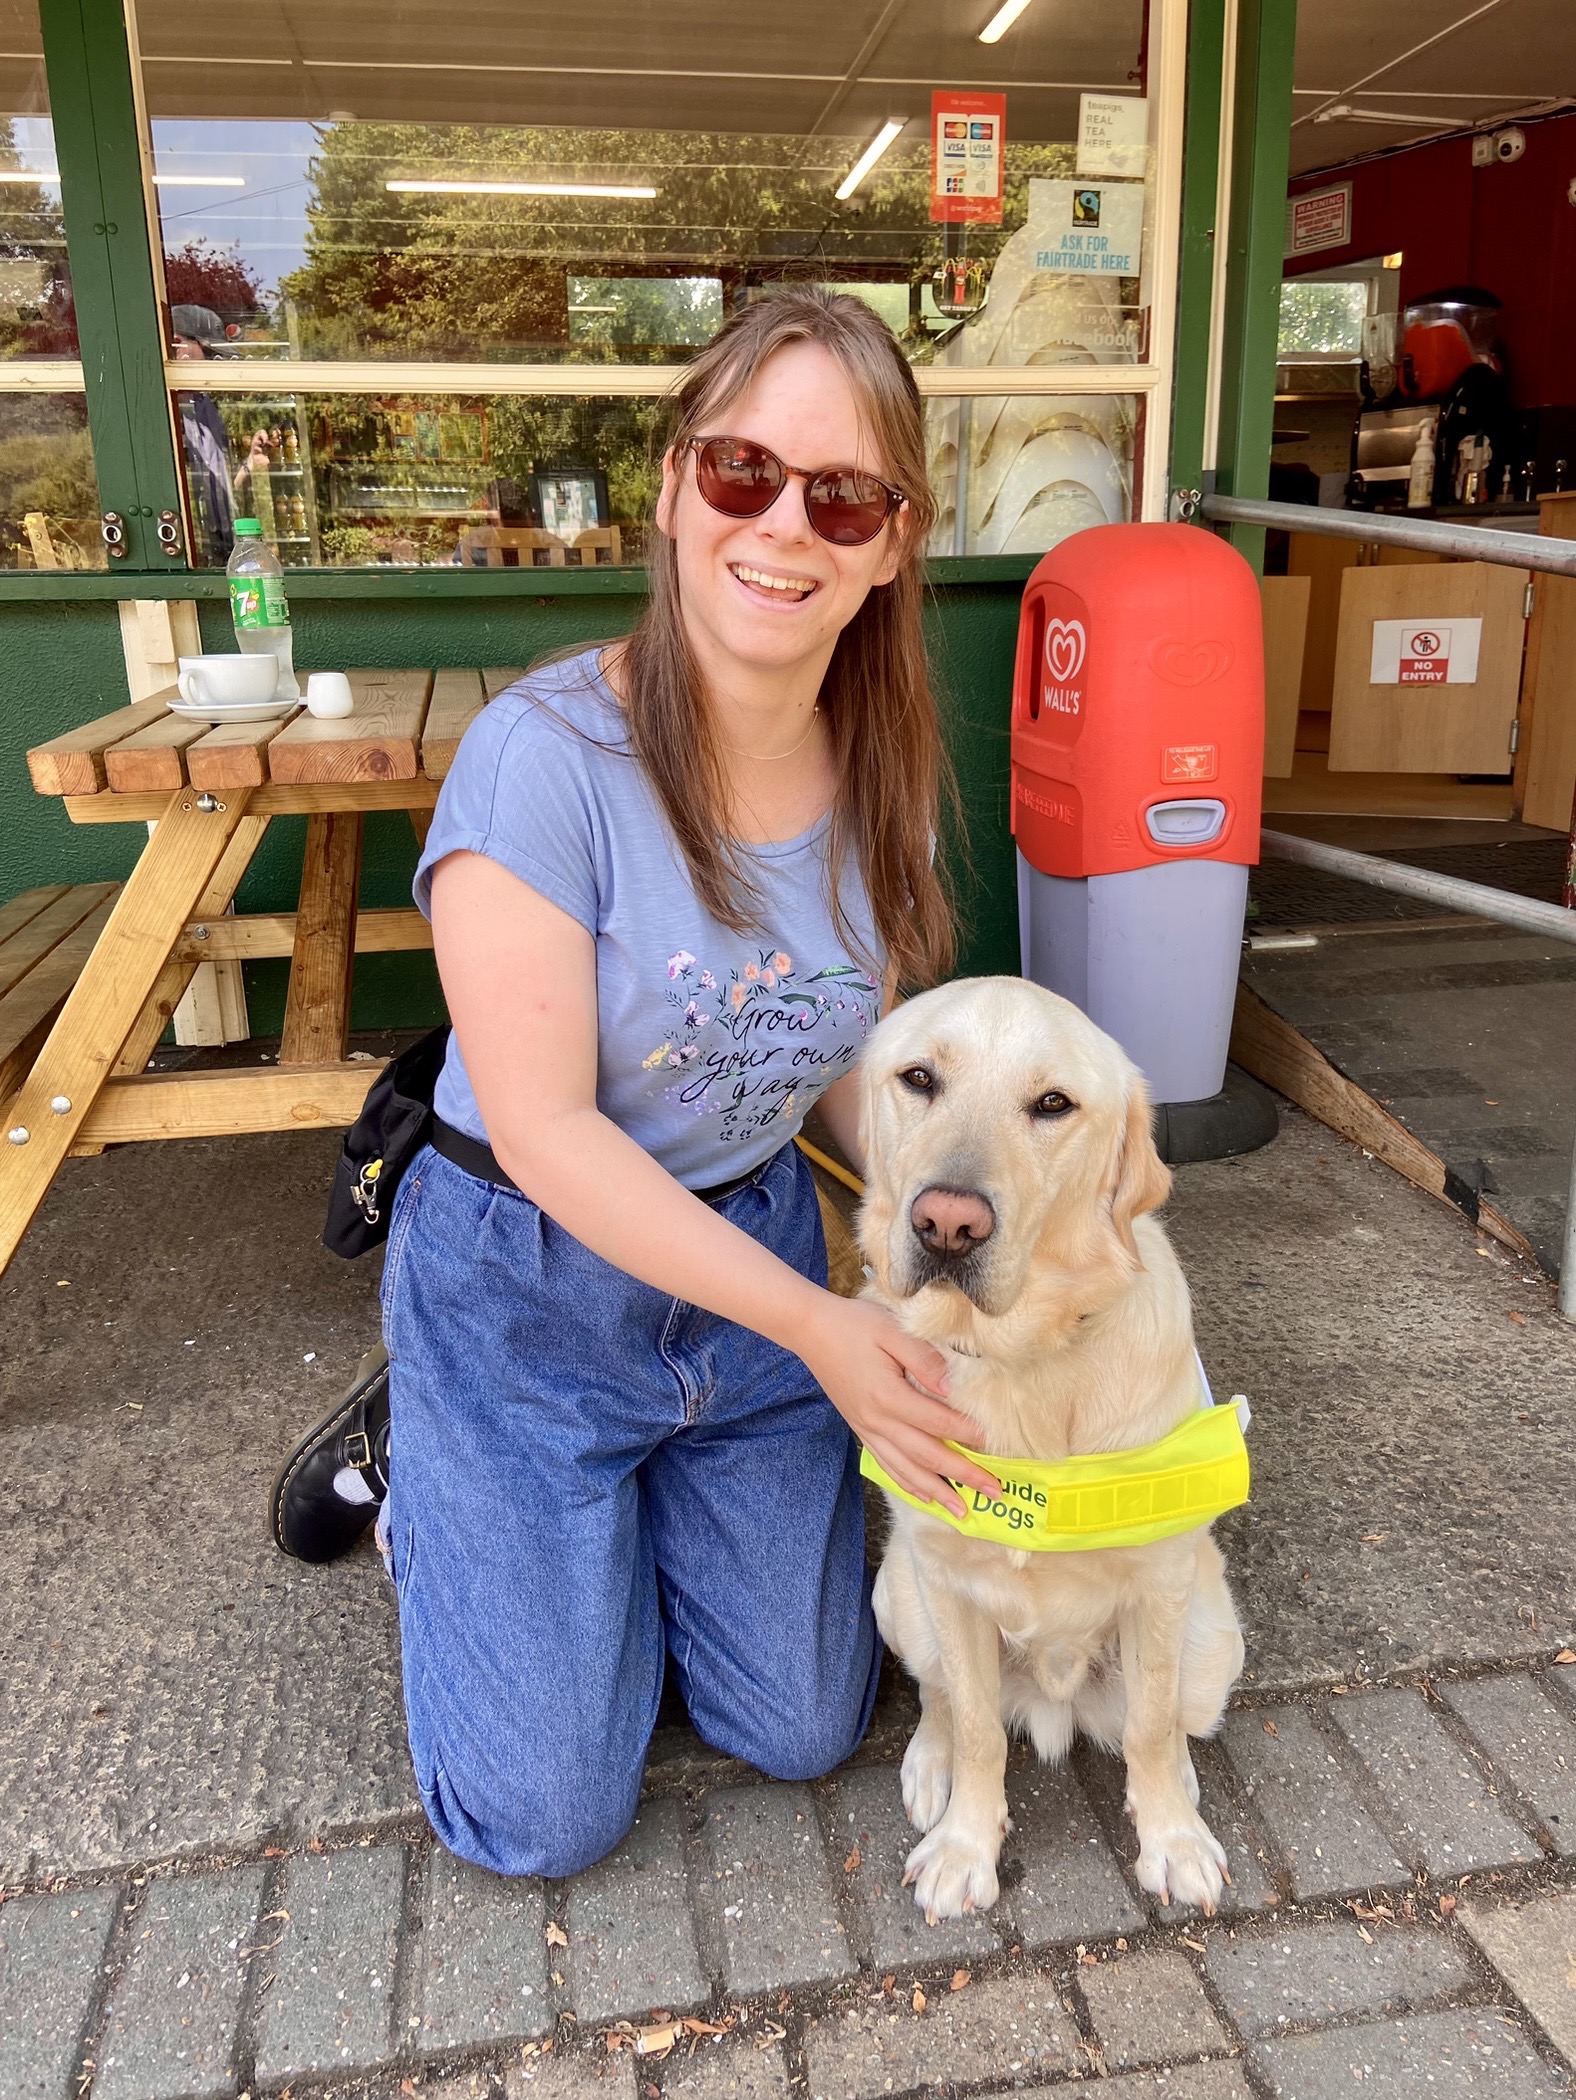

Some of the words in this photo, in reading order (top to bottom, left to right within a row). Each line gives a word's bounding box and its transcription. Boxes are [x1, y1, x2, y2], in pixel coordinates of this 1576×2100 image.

[1086, 114, 1113, 125] REAL
[1085, 126, 1106, 136] TEA
[947, 143, 965, 151] VISA
[973, 144, 992, 152] VISA
[1084, 138, 1112, 149] HERE
[1296, 194, 1344, 213] WARNING
[1060, 234, 1083, 250] ASK
[1086, 236, 1109, 252] FOR
[1036, 251, 1097, 269] FAIRTRADE
[1101, 254, 1131, 271] HERE
[1413, 661, 1433, 670] NO
[1401, 671, 1444, 681] ENTRY
[1044, 685, 1080, 715] WALL'S
[732, 997, 824, 1050] Grow
[680, 1047, 784, 1104] your
[792, 1043, 856, 1067] own
[732, 1076, 805, 1127] way
[998, 1478, 1048, 1508] uide
[972, 1490, 1035, 1530] Dogs
